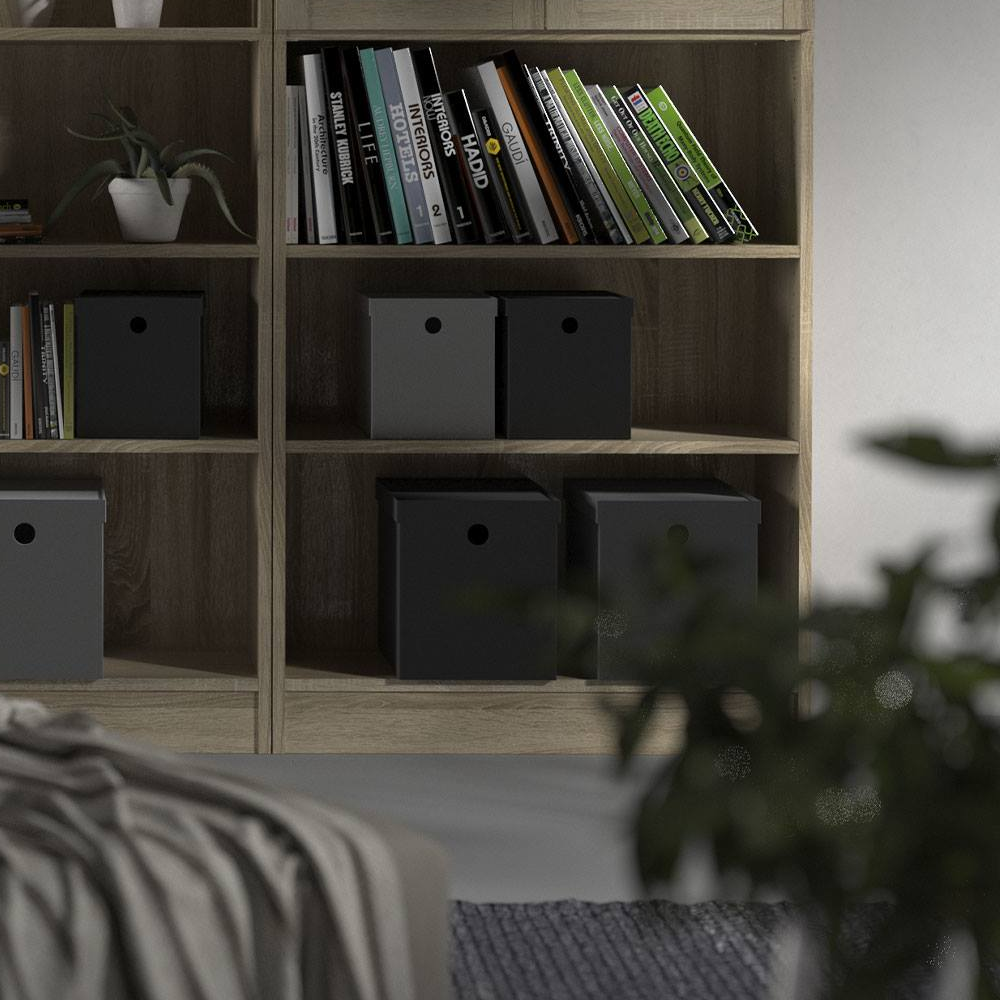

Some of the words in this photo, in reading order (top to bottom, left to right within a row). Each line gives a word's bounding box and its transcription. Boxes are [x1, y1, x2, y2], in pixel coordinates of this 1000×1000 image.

[330, 91, 347, 136] STANLEY
[422, 95, 436, 121] NOW
[431, 92, 456, 157] INTERIORS
[318, 114, 328, 175] Architecture
[336, 139, 354, 185] KUBRICK
[358, 122, 378, 165] LIFE
[390, 103, 419, 183] HOTELS
[408, 103, 435, 180] INTERIORS
[461, 133, 489, 189] HADID
[502, 122, 529, 165] GAUDÍ
[546, 120, 571, 171] TRINITY
[416, 205, 424, 218] 1
[432, 204, 442, 217] 2
[456, 206, 465, 219] 1
